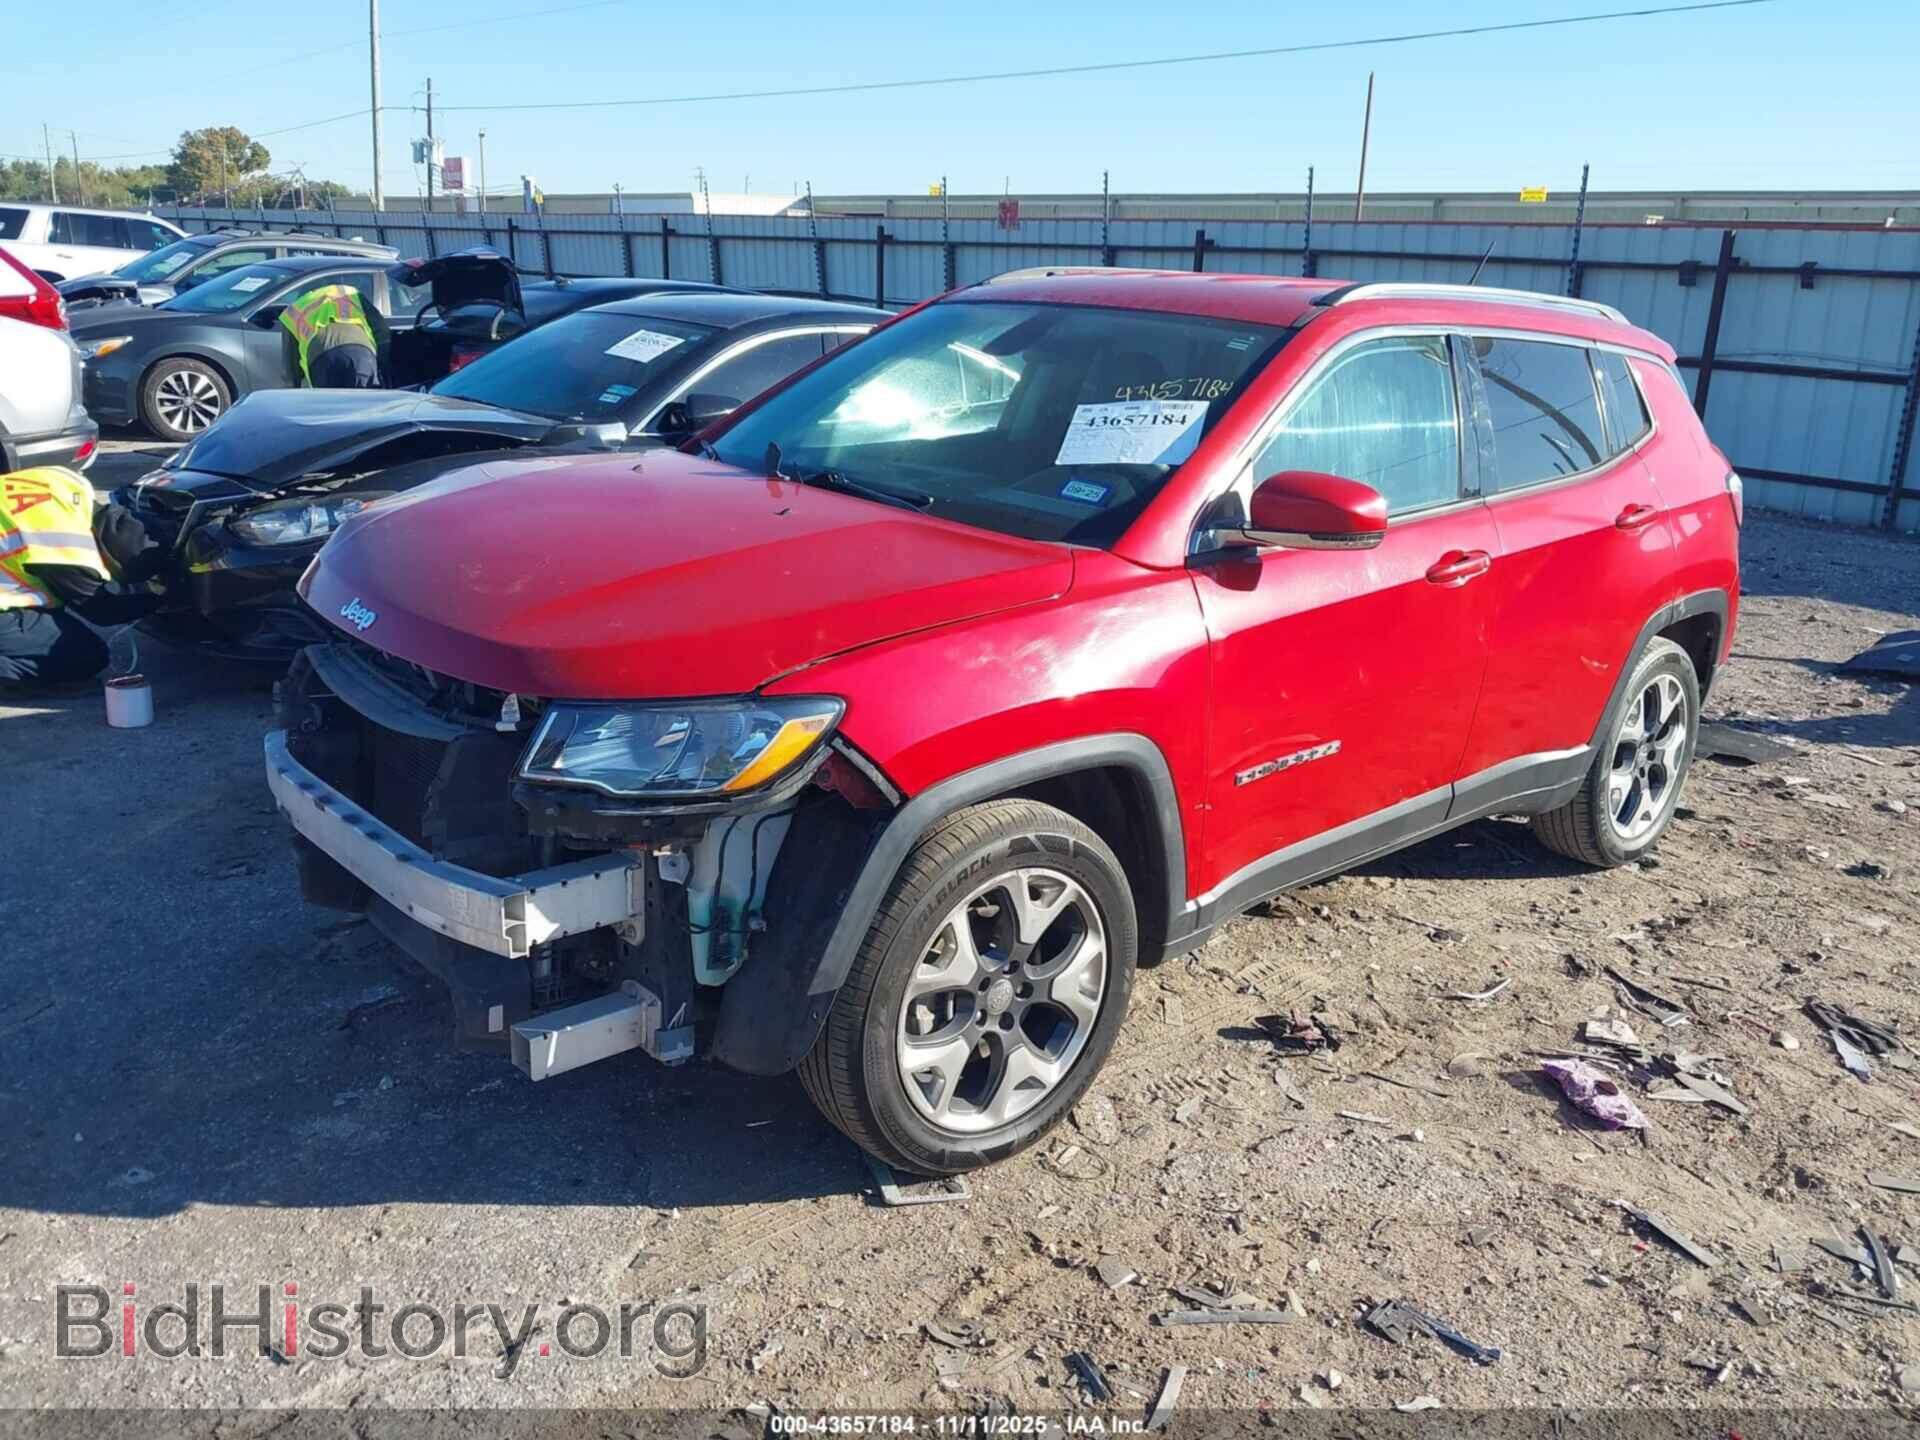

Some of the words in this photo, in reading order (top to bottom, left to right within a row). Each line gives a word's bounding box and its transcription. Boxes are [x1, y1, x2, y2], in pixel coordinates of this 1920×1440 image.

[1114, 377, 1234, 402] 43657184
[1087, 413, 1188, 428] 43657184
[340, 597, 377, 632] Jeep
